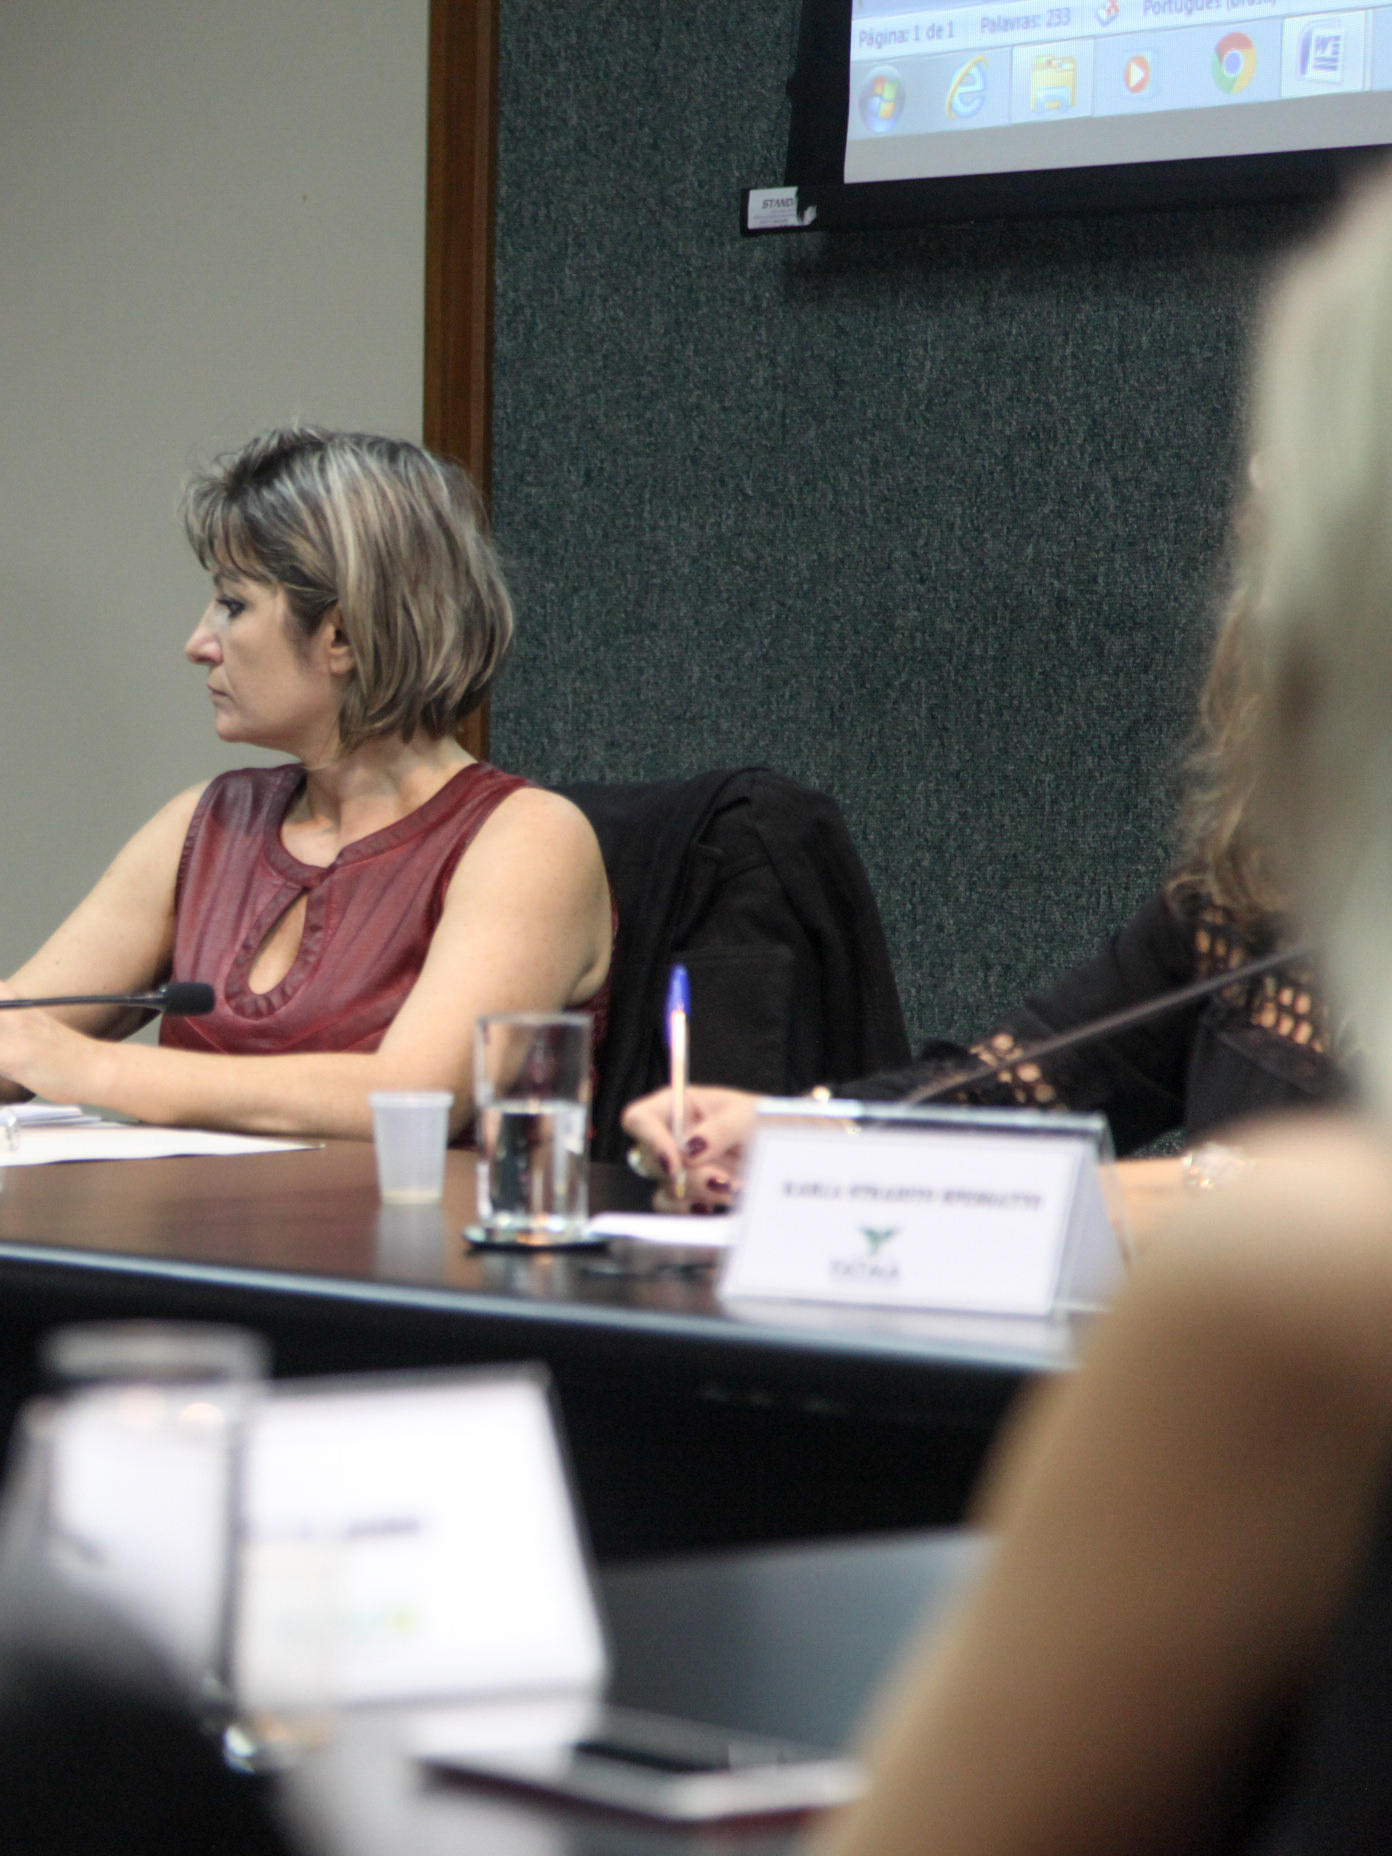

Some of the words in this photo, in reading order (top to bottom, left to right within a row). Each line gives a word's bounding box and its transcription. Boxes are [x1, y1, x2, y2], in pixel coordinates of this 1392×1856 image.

[980, 14, 1041, 34] Palavras:
[1046, 7, 1072, 27] 233
[858, 28, 908, 49] Página:
[913, 25, 920, 41] 1
[926, 25, 943, 40] de
[947, 21, 954, 38] 1
